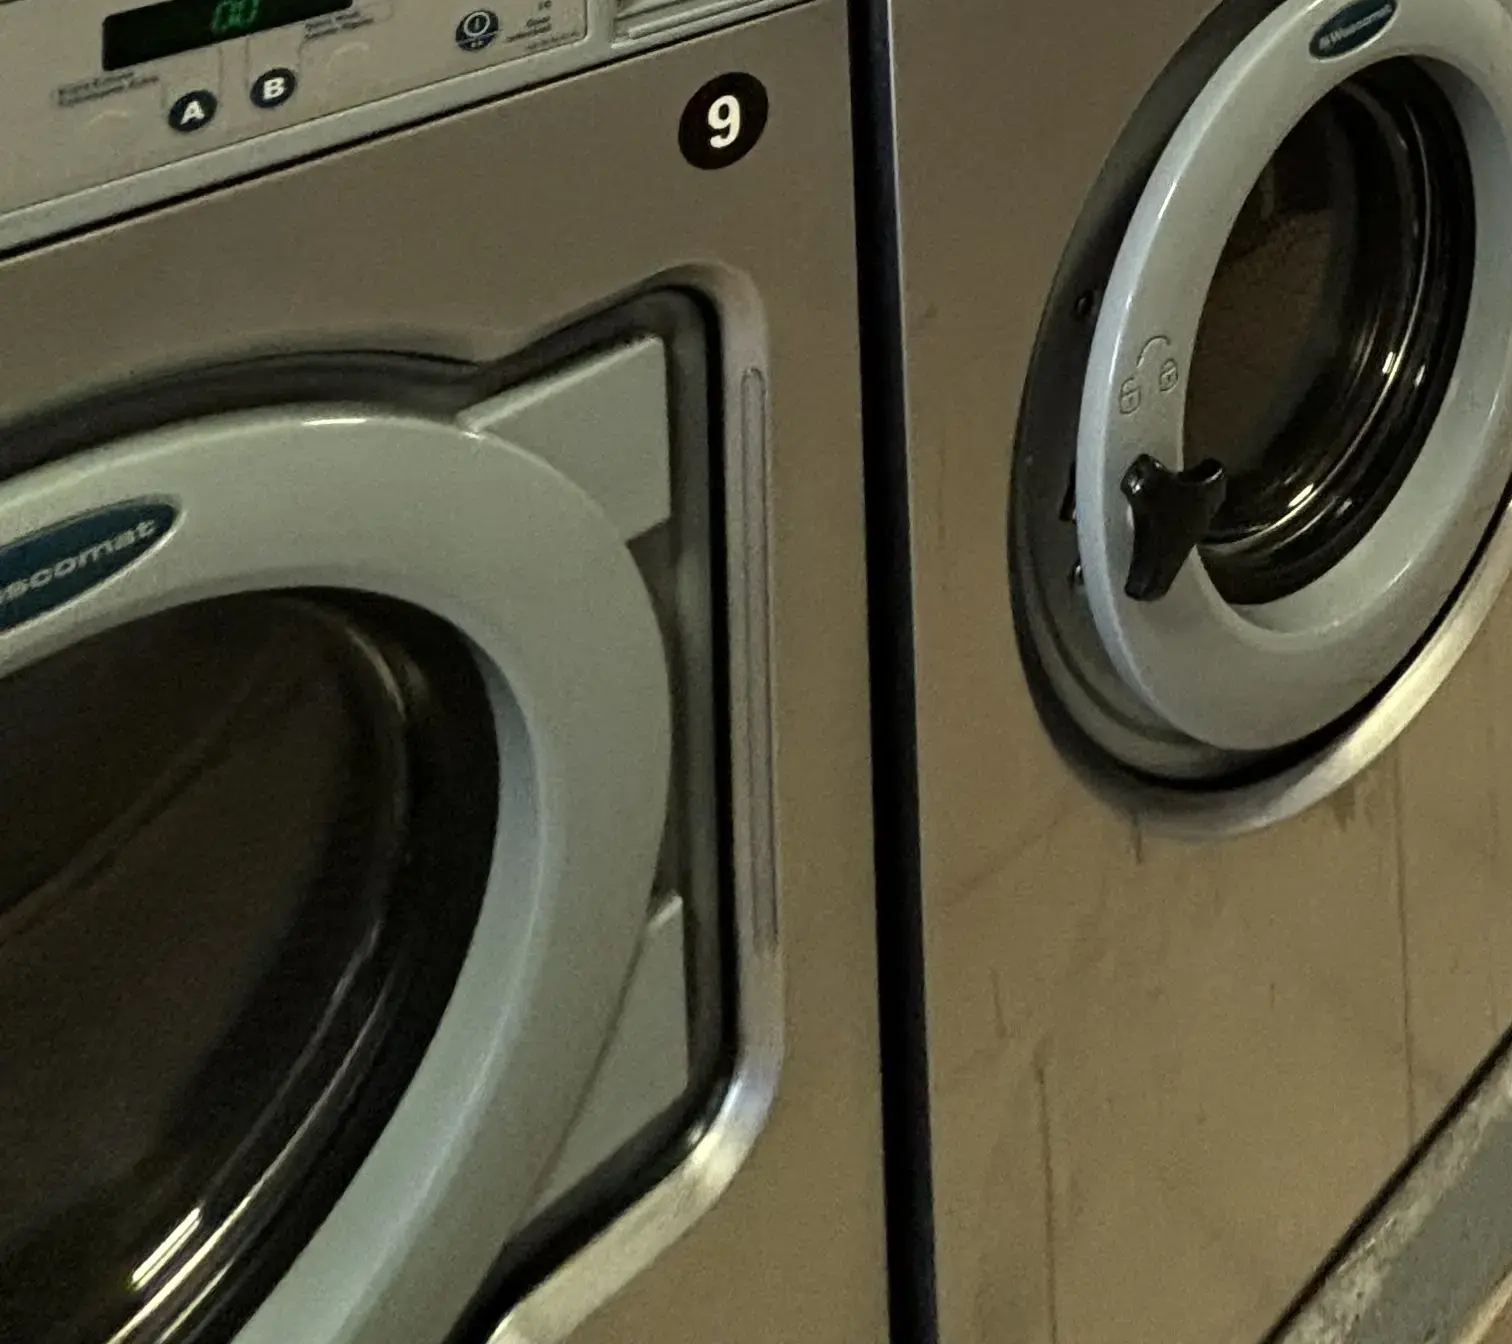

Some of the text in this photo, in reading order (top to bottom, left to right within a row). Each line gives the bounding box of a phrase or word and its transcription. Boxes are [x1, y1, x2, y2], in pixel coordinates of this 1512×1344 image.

[180, 77, 286, 126] A B
[707, 94, 742, 149] 9
